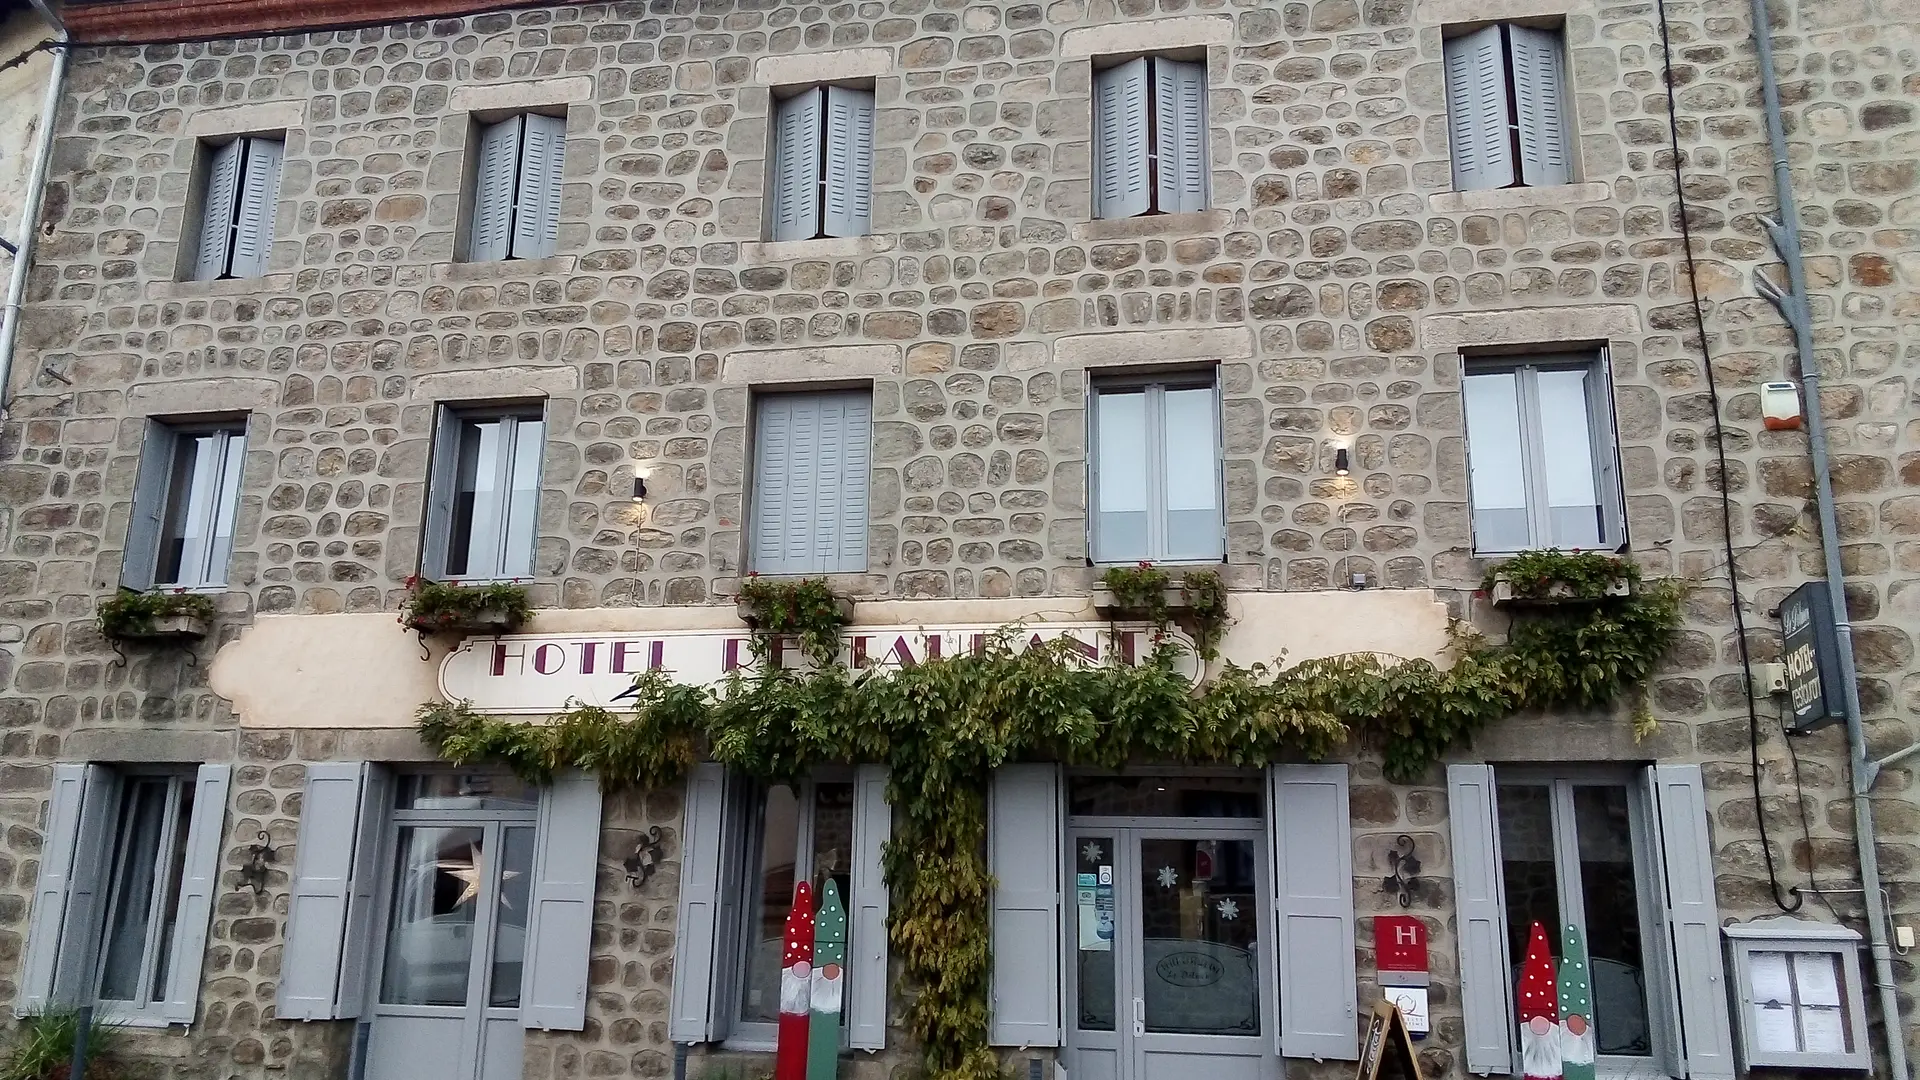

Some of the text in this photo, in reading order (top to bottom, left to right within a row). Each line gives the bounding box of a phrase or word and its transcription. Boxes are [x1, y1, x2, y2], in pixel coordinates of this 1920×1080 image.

[489, 640, 678, 676] HOTEL
[1792, 676, 1821, 710] restauran
[1394, 925, 1418, 945] H
